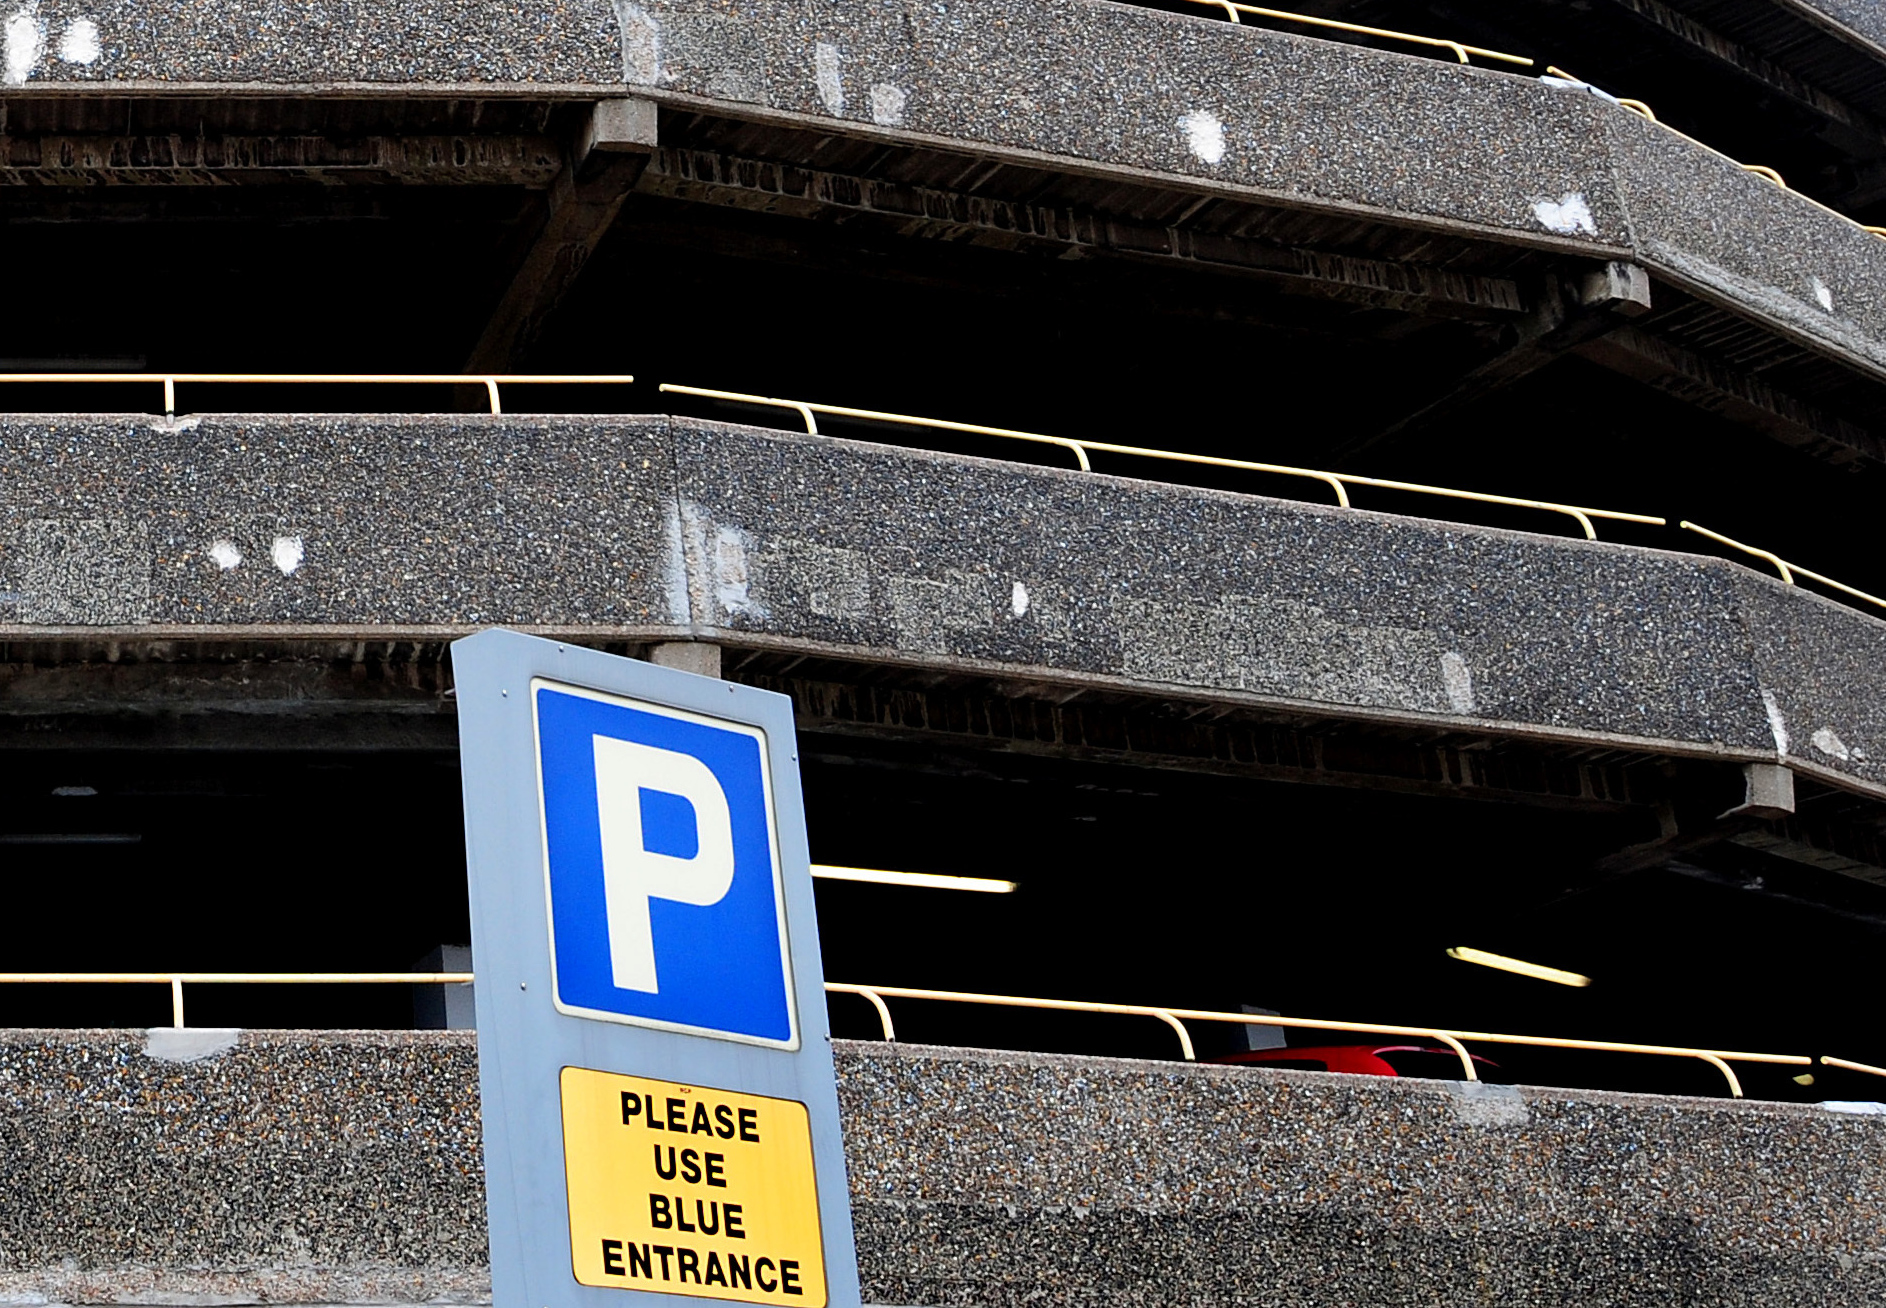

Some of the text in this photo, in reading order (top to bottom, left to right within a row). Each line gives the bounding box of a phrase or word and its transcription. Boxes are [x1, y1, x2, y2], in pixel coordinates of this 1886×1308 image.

[592, 733, 735, 995] P
[620, 1091, 760, 1143] PLEASE
[654, 1144, 727, 1188] USE
[649, 1193, 746, 1240] BLUE
[601, 1239, 803, 1296] ENTRANCE
